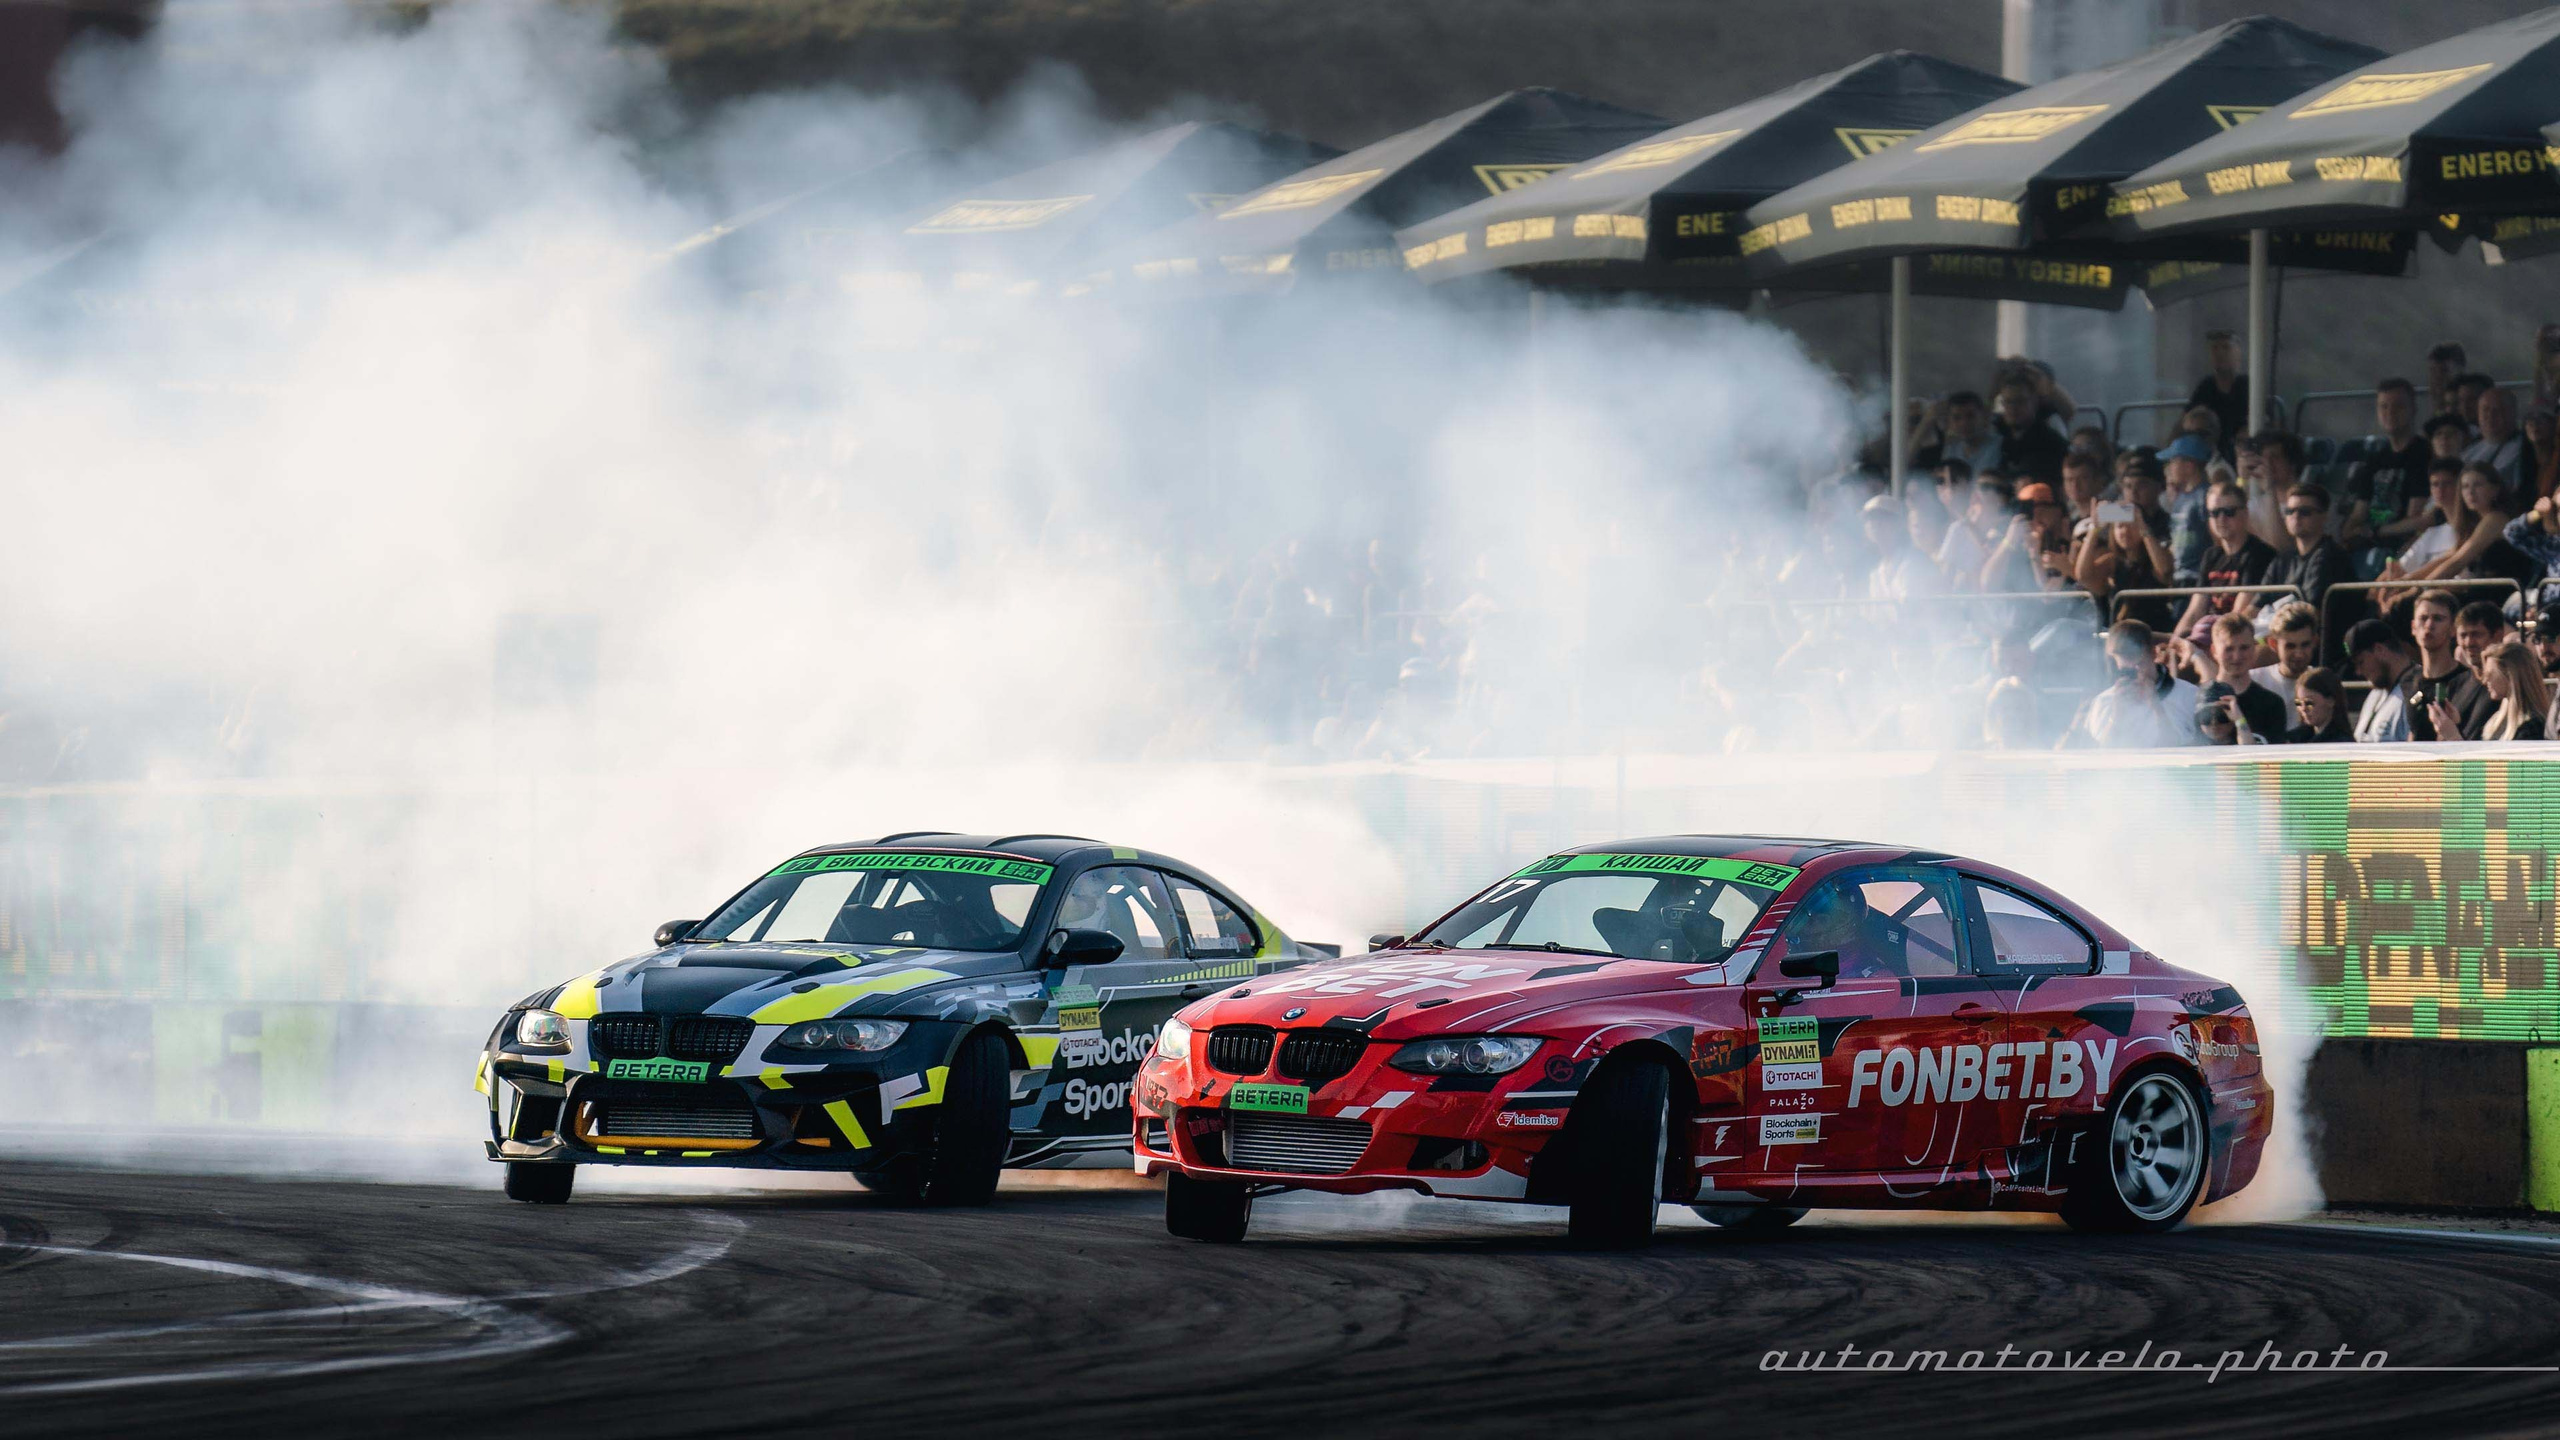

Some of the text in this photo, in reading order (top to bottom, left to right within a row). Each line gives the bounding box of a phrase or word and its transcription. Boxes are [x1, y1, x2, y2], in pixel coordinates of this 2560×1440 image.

[2206, 165, 2254, 196] ENERGY
[825, 855, 996, 873] ВИШНЕВСКИЙ
[1599, 855, 1710, 873] КАПШАЙ
[1750, 866, 1787, 878] BET
[1475, 879, 1542, 904] 17
[1252, 974, 1473, 999] BET
[612, 1063, 702, 1080] BET.ERA
[1847, 1038, 2118, 1109] FONBET.BY
[1235, 1089, 1304, 1108] BET.ERA
[1514, 1113, 1559, 1126] idemitsu
[1765, 1118, 1813, 1128] Blockchain
[1764, 1129, 1795, 1141] Sports
